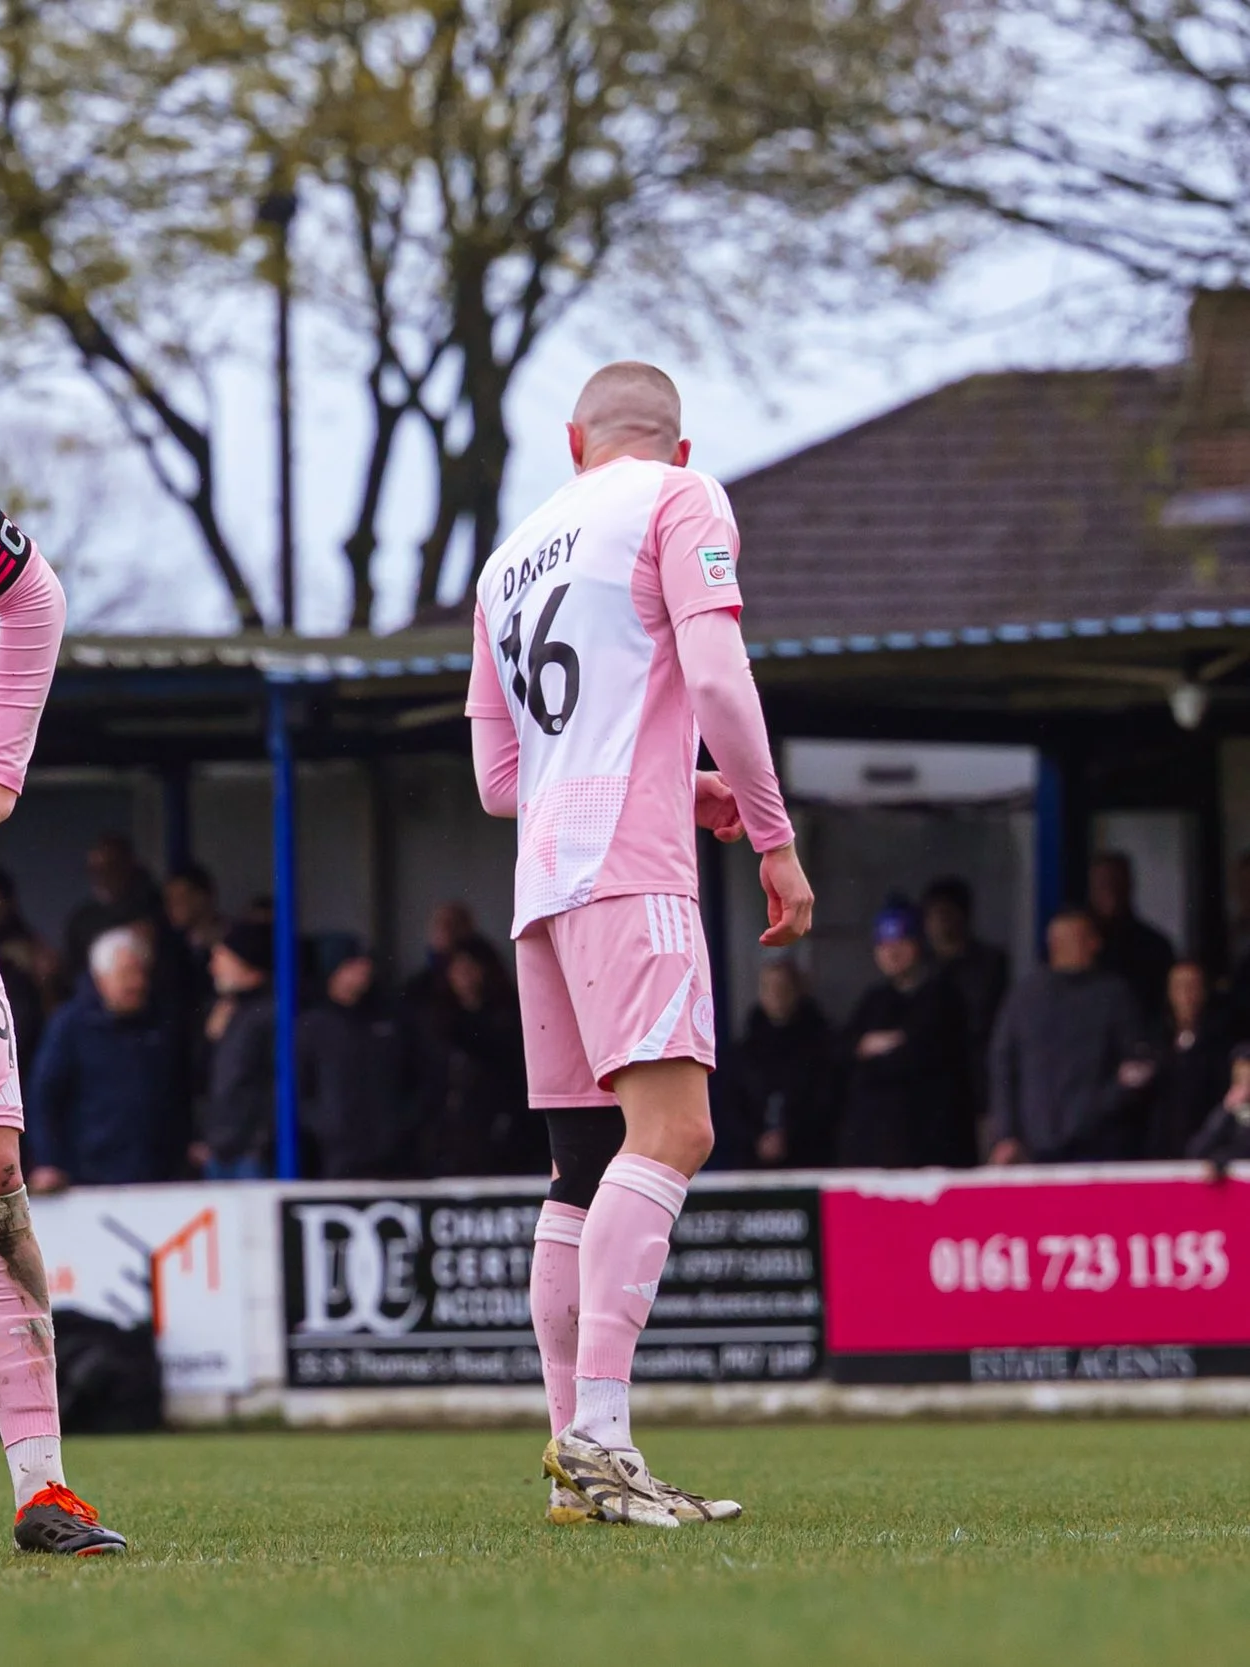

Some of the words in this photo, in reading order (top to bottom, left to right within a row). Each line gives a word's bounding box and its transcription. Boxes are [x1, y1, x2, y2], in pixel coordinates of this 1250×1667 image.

[504, 527, 581, 601] DARBY
[499, 582, 580, 736] 16
[430, 1207, 541, 1247] CHART
[431, 1248, 533, 1288] CERT
[930, 1234, 1031, 1293] 0161
[1037, 1232, 1120, 1293] 723
[1127, 1229, 1229, 1291] 1155
[432, 1287, 532, 1327] ACCOU
[969, 1345, 1070, 1381] ESTATE
[1074, 1343, 1197, 1379] AGENTS
